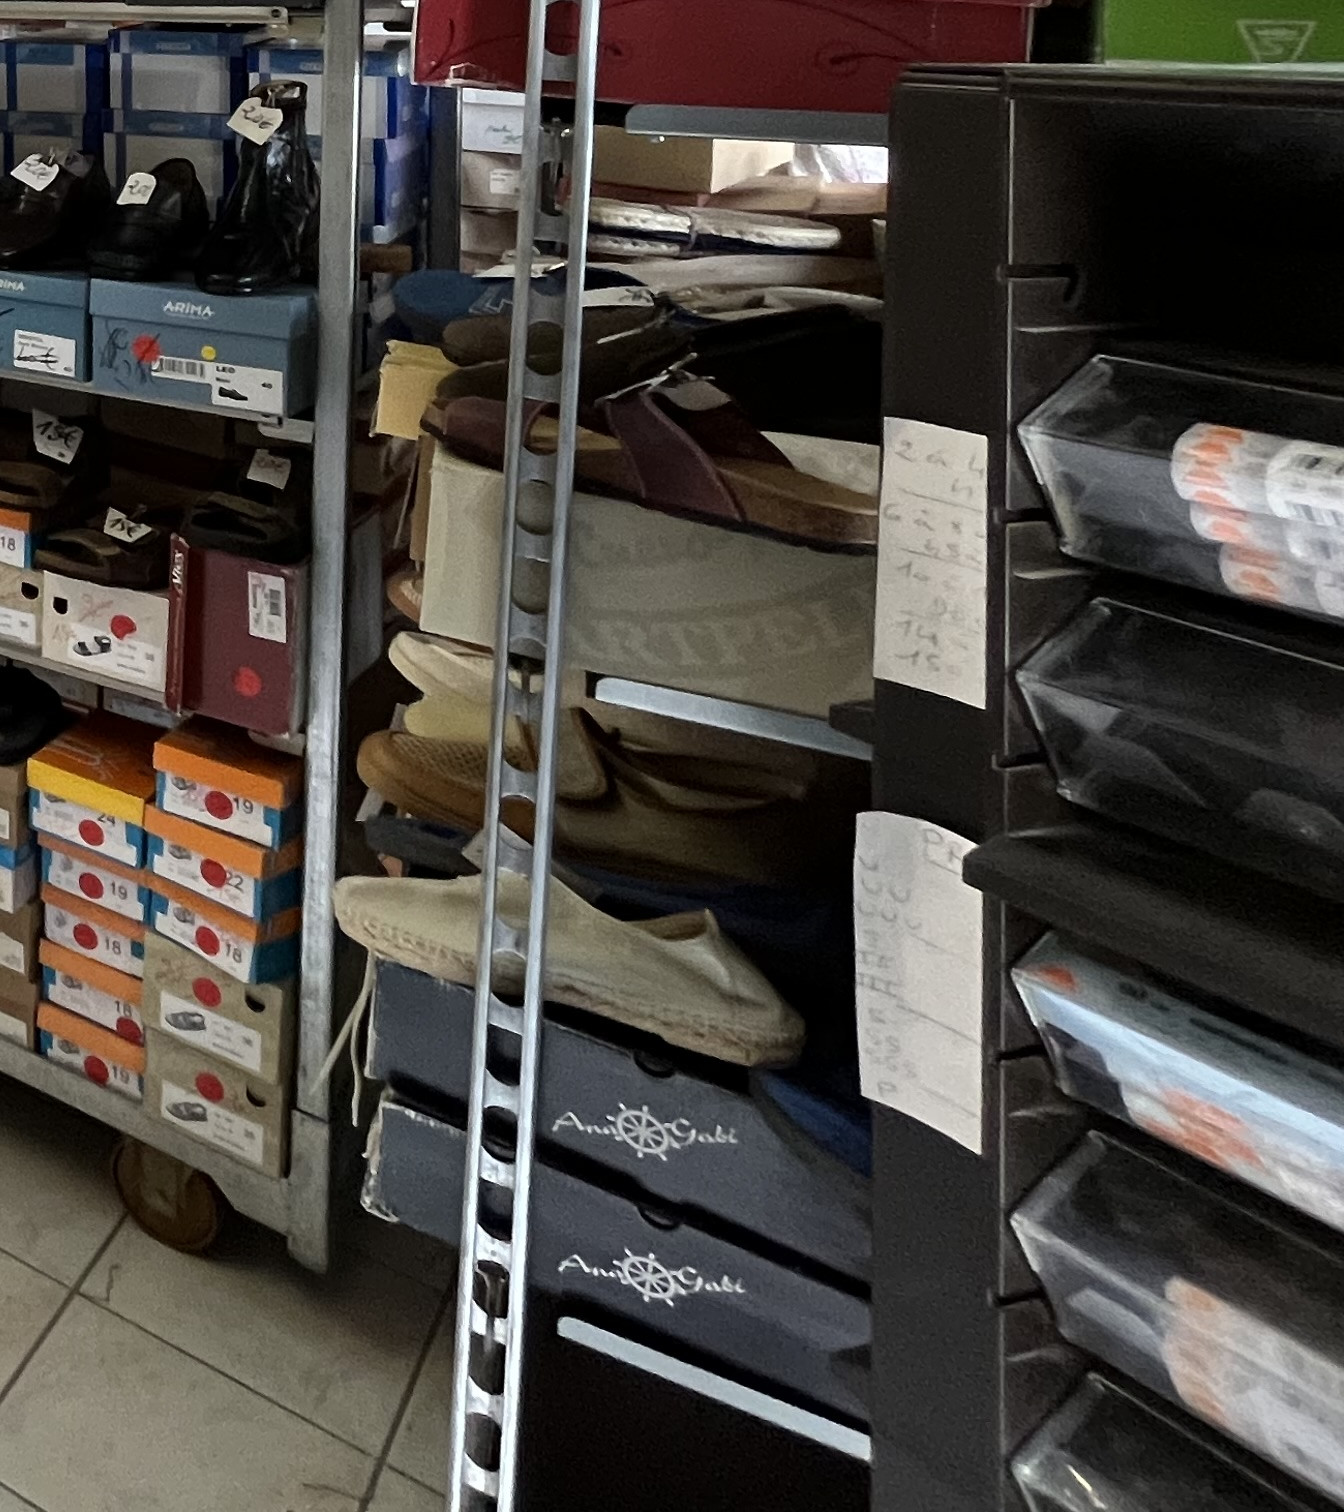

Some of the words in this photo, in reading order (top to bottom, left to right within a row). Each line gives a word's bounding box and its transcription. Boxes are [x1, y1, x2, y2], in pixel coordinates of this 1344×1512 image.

[162, 301, 216, 318] ARIMA
[0, 535, 16, 551] 18
[232, 796, 254, 815] 19
[110, 881, 128, 900] 19
[104, 936, 122, 955] 18
[225, 942, 243, 963] 18
[114, 999, 132, 1018] 18
[112, 1066, 130, 1085] 19
